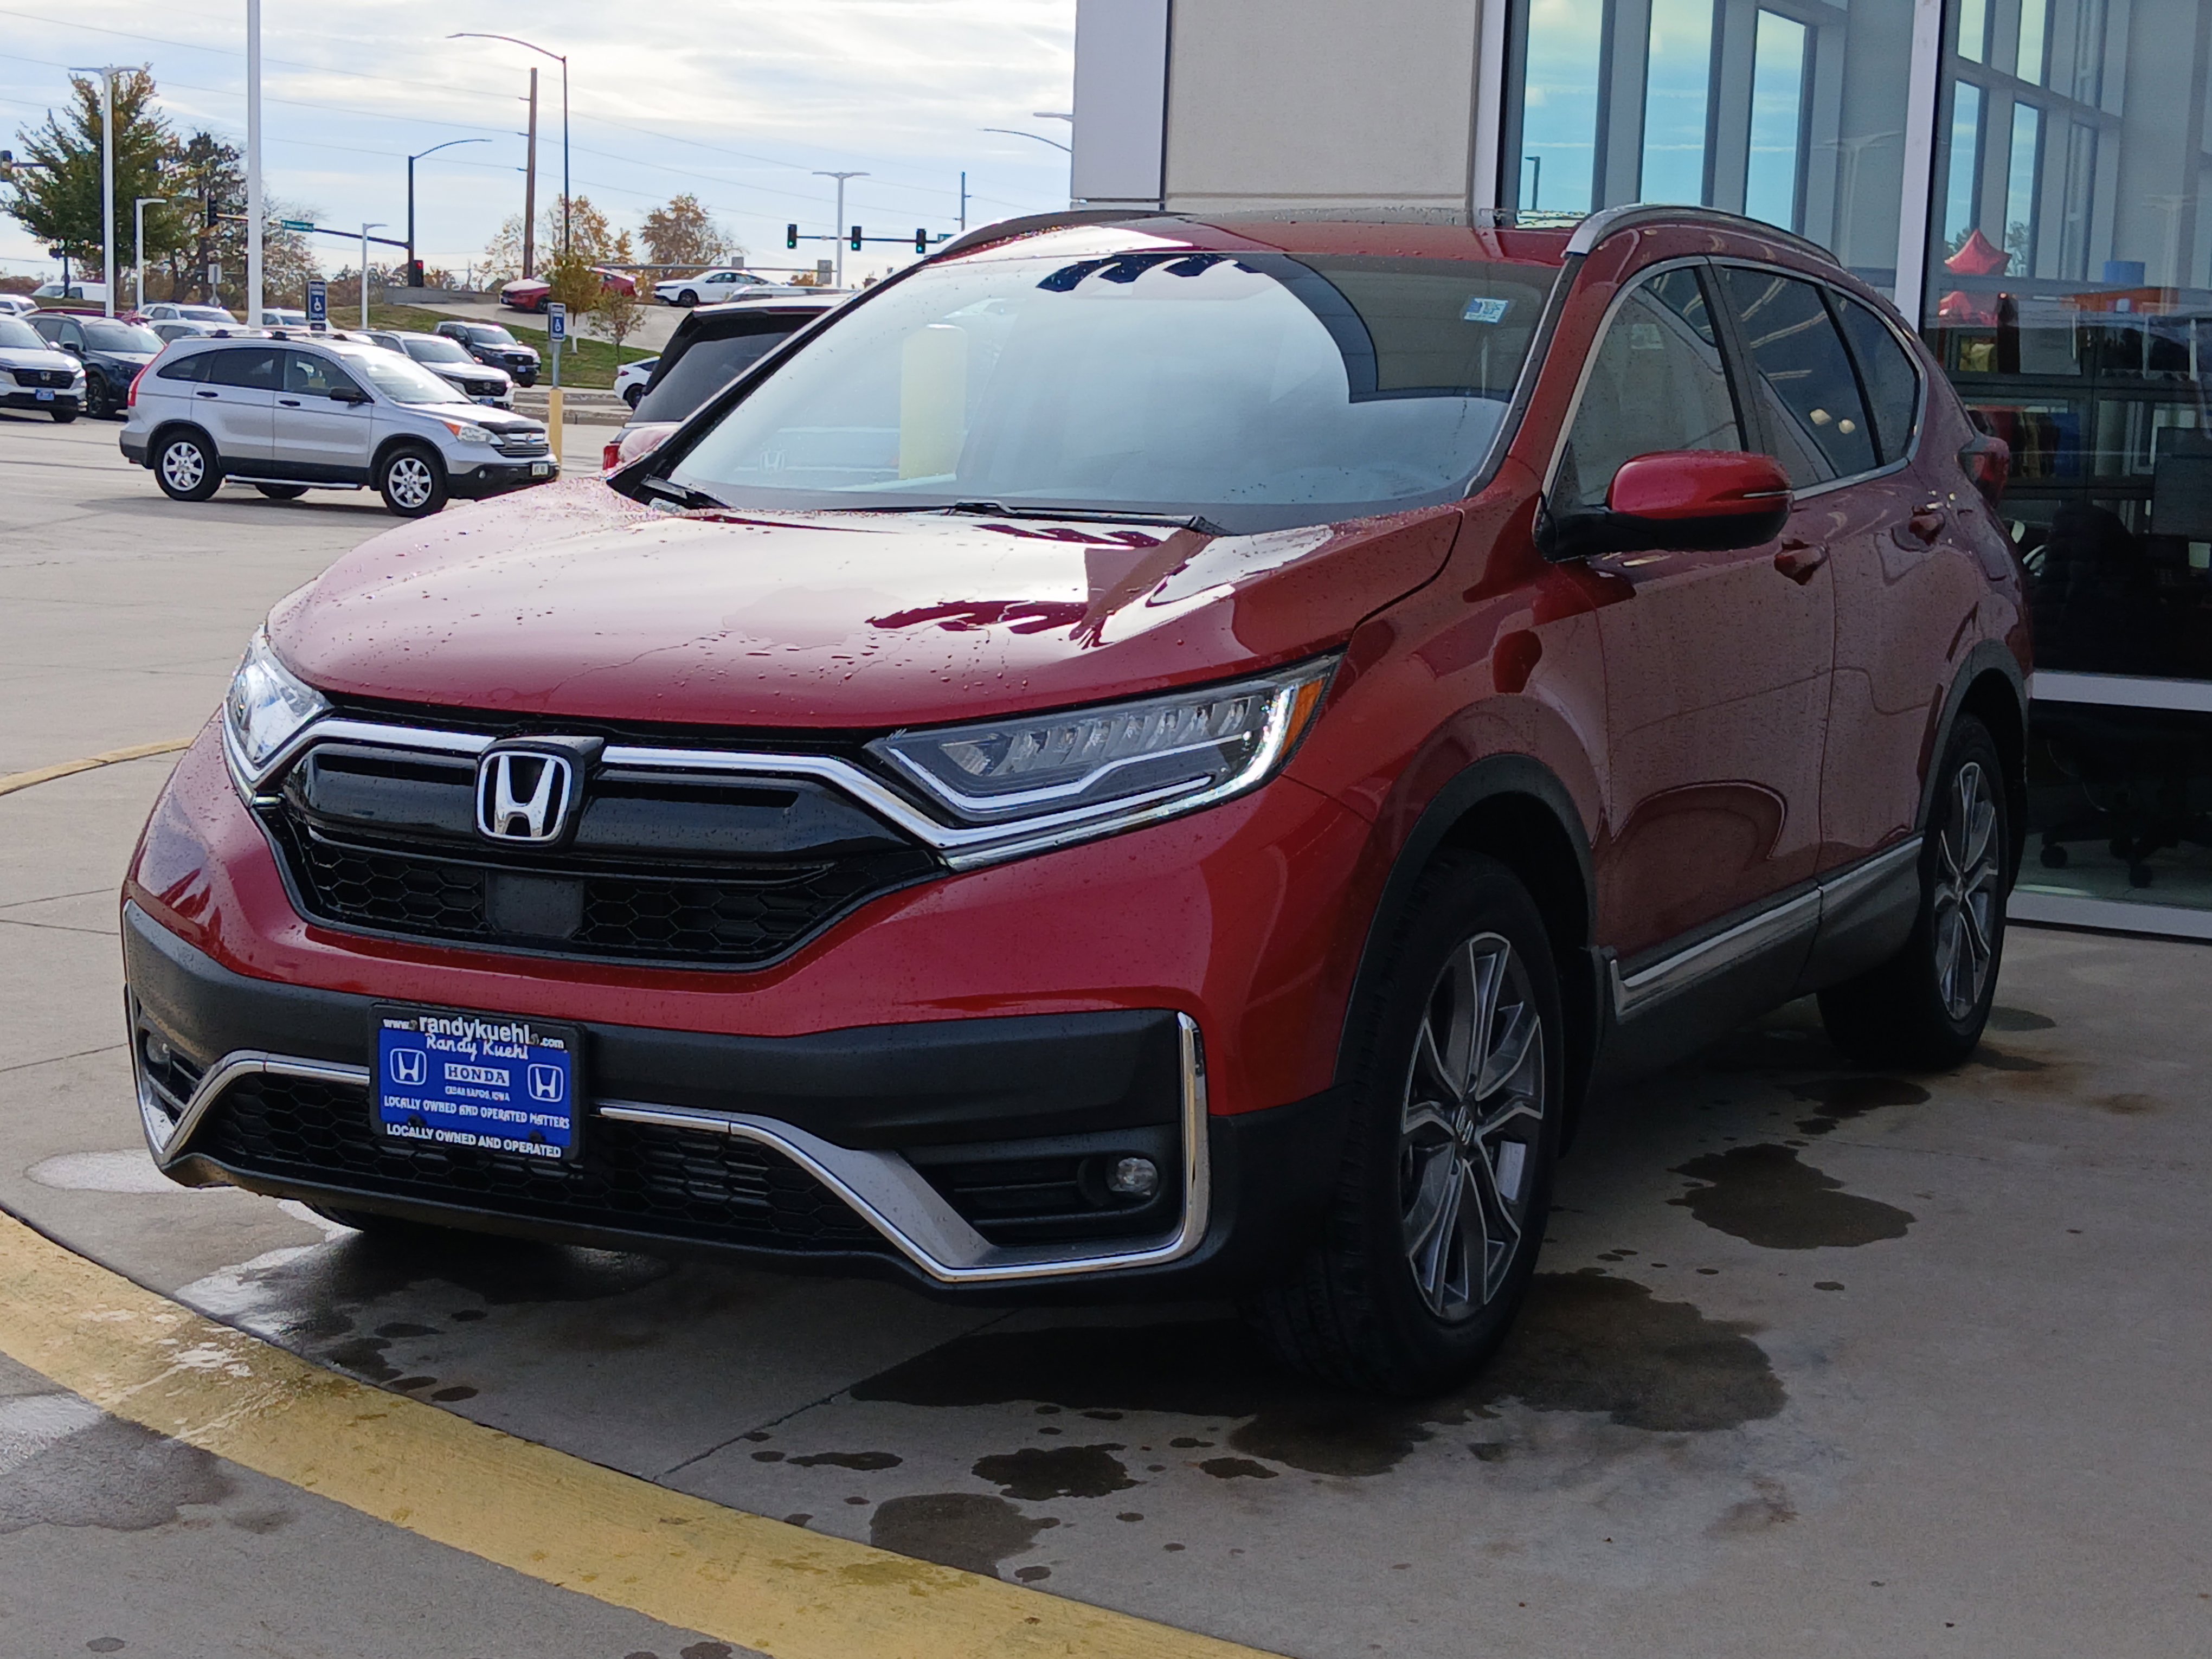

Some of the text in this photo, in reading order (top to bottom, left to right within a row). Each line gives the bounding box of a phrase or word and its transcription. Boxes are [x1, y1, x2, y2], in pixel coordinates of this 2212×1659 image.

[425, 1033, 529, 1062] Randy Kuehl
[448, 1065, 506, 1084] HONDA
[384, 1095, 570, 1130] LOCALLY OWNED AND OPERATED MATTERS
[387, 1123, 562, 1158] LOCALLY OWNED AND OPERATED
